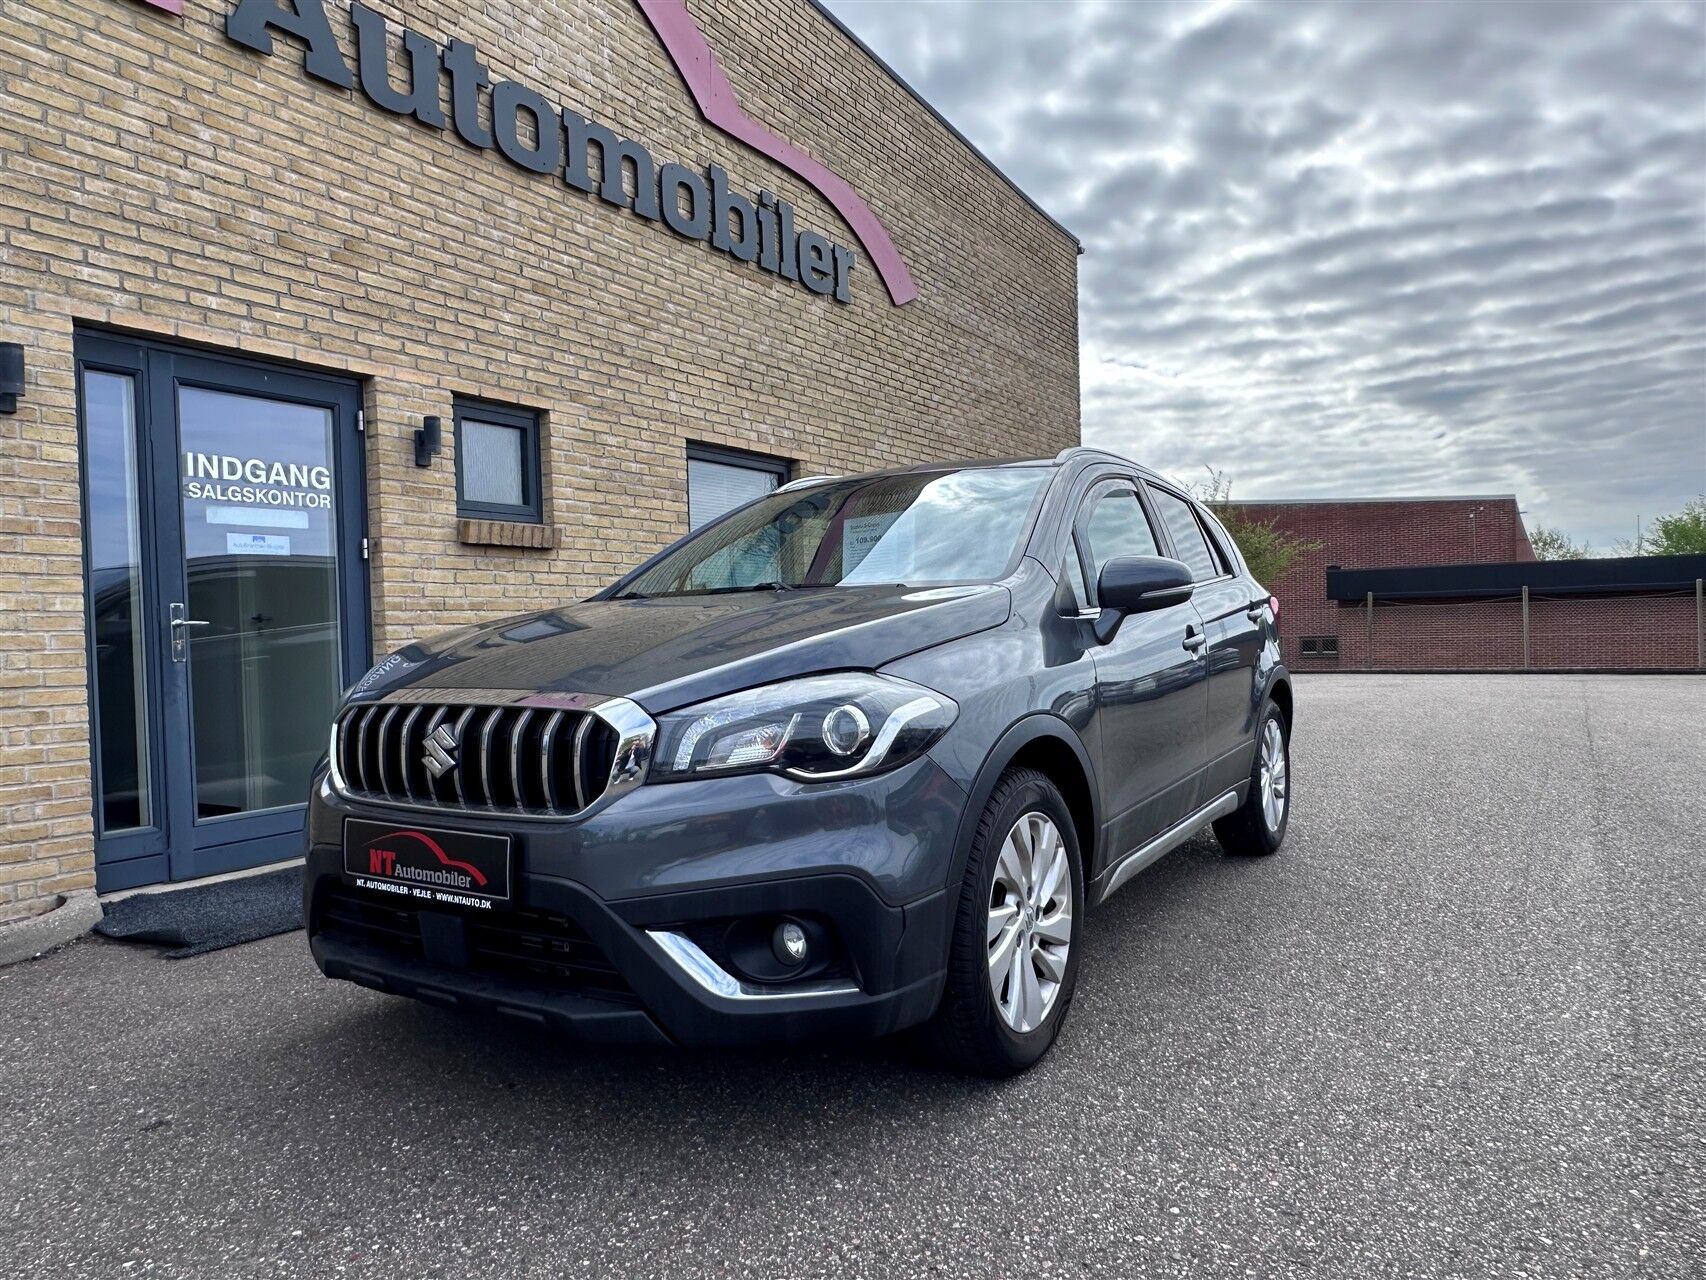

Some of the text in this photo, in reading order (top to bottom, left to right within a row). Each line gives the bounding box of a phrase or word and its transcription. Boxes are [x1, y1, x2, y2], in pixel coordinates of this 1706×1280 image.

[225, 0, 857, 304] Automobiler
[186, 451, 331, 490] INDGANG
[188, 482, 331, 509] SALGSKONTOR
[369, 849, 471, 888] NT Automobiler
[366, 880, 409, 894] AUTOMOBILER
[412, 888, 432, 898] VEJLE
[436, 892, 492, 909] WWW.NTAUTO.DK
